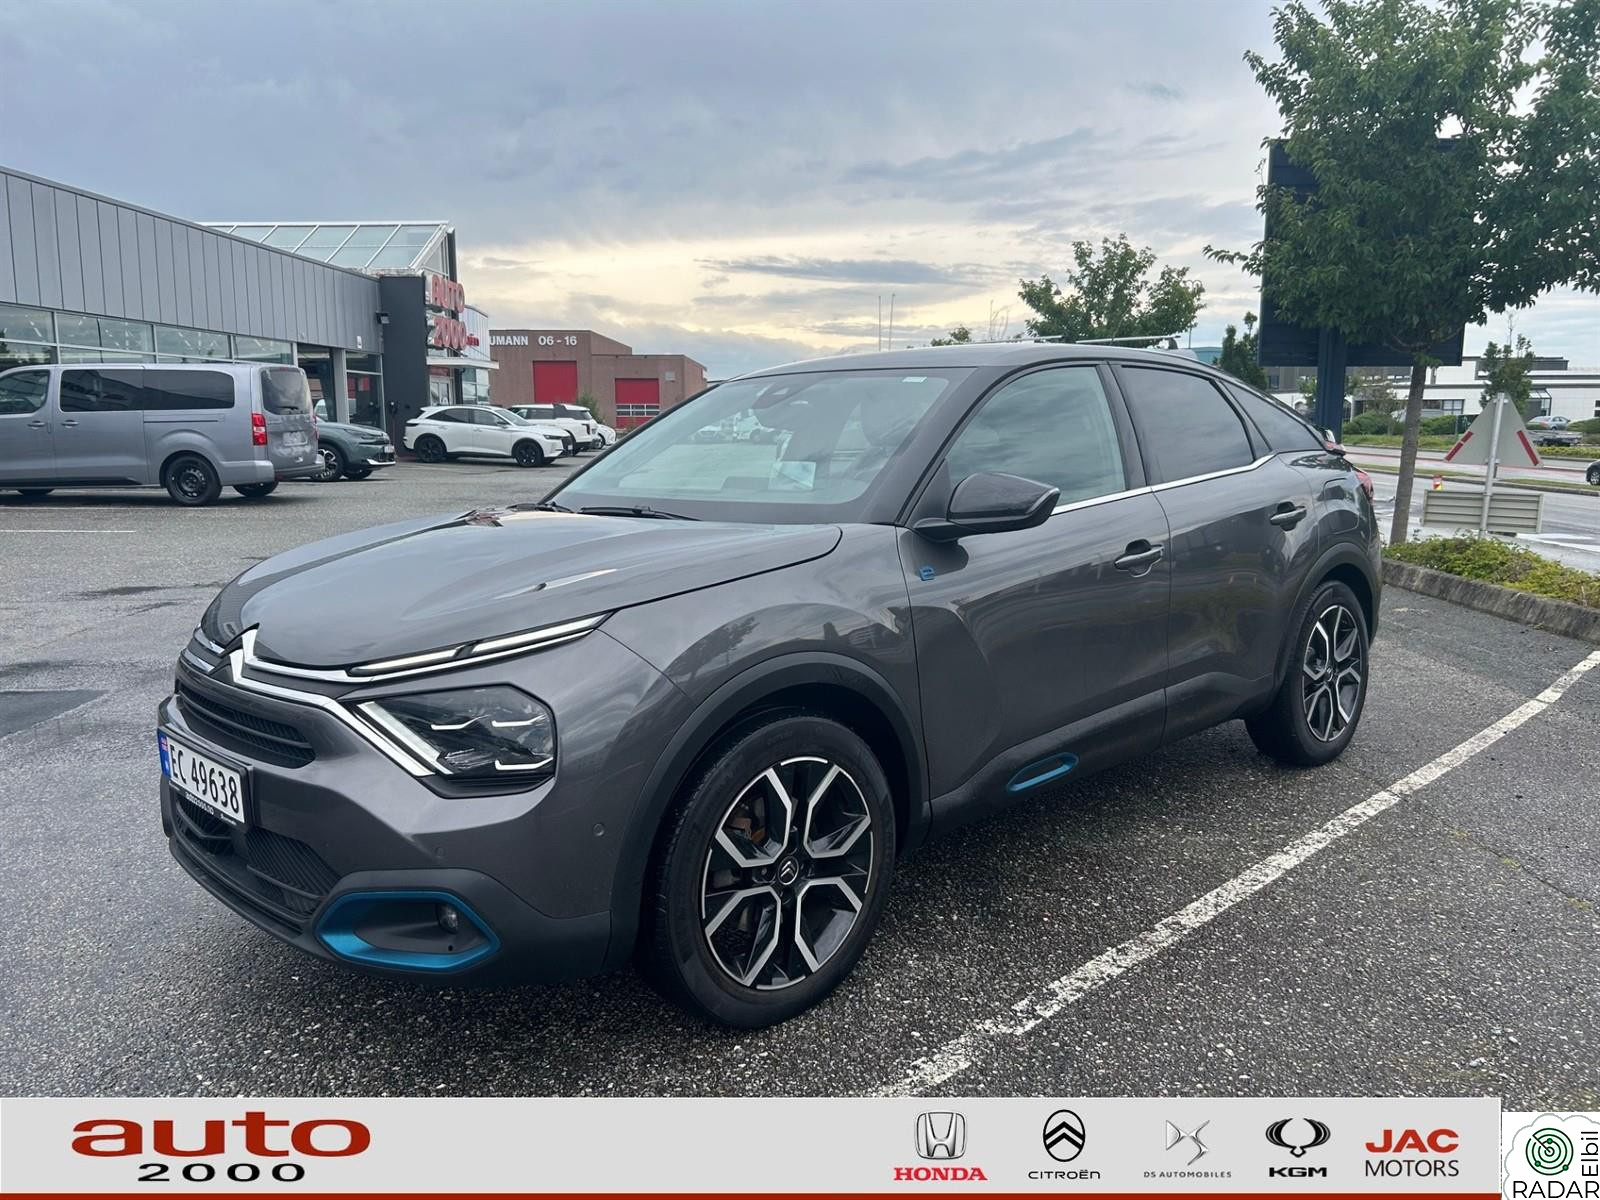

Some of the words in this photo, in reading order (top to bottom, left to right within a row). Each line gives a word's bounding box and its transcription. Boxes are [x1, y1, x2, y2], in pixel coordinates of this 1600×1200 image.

[431, 273, 465, 314] AUTO
[433, 315, 467, 350] 2000
[538, 335, 554, 346] 06
[564, 335, 578, 346] 16
[170, 744, 187, 784] EC
[191, 757, 240, 814] 49638
